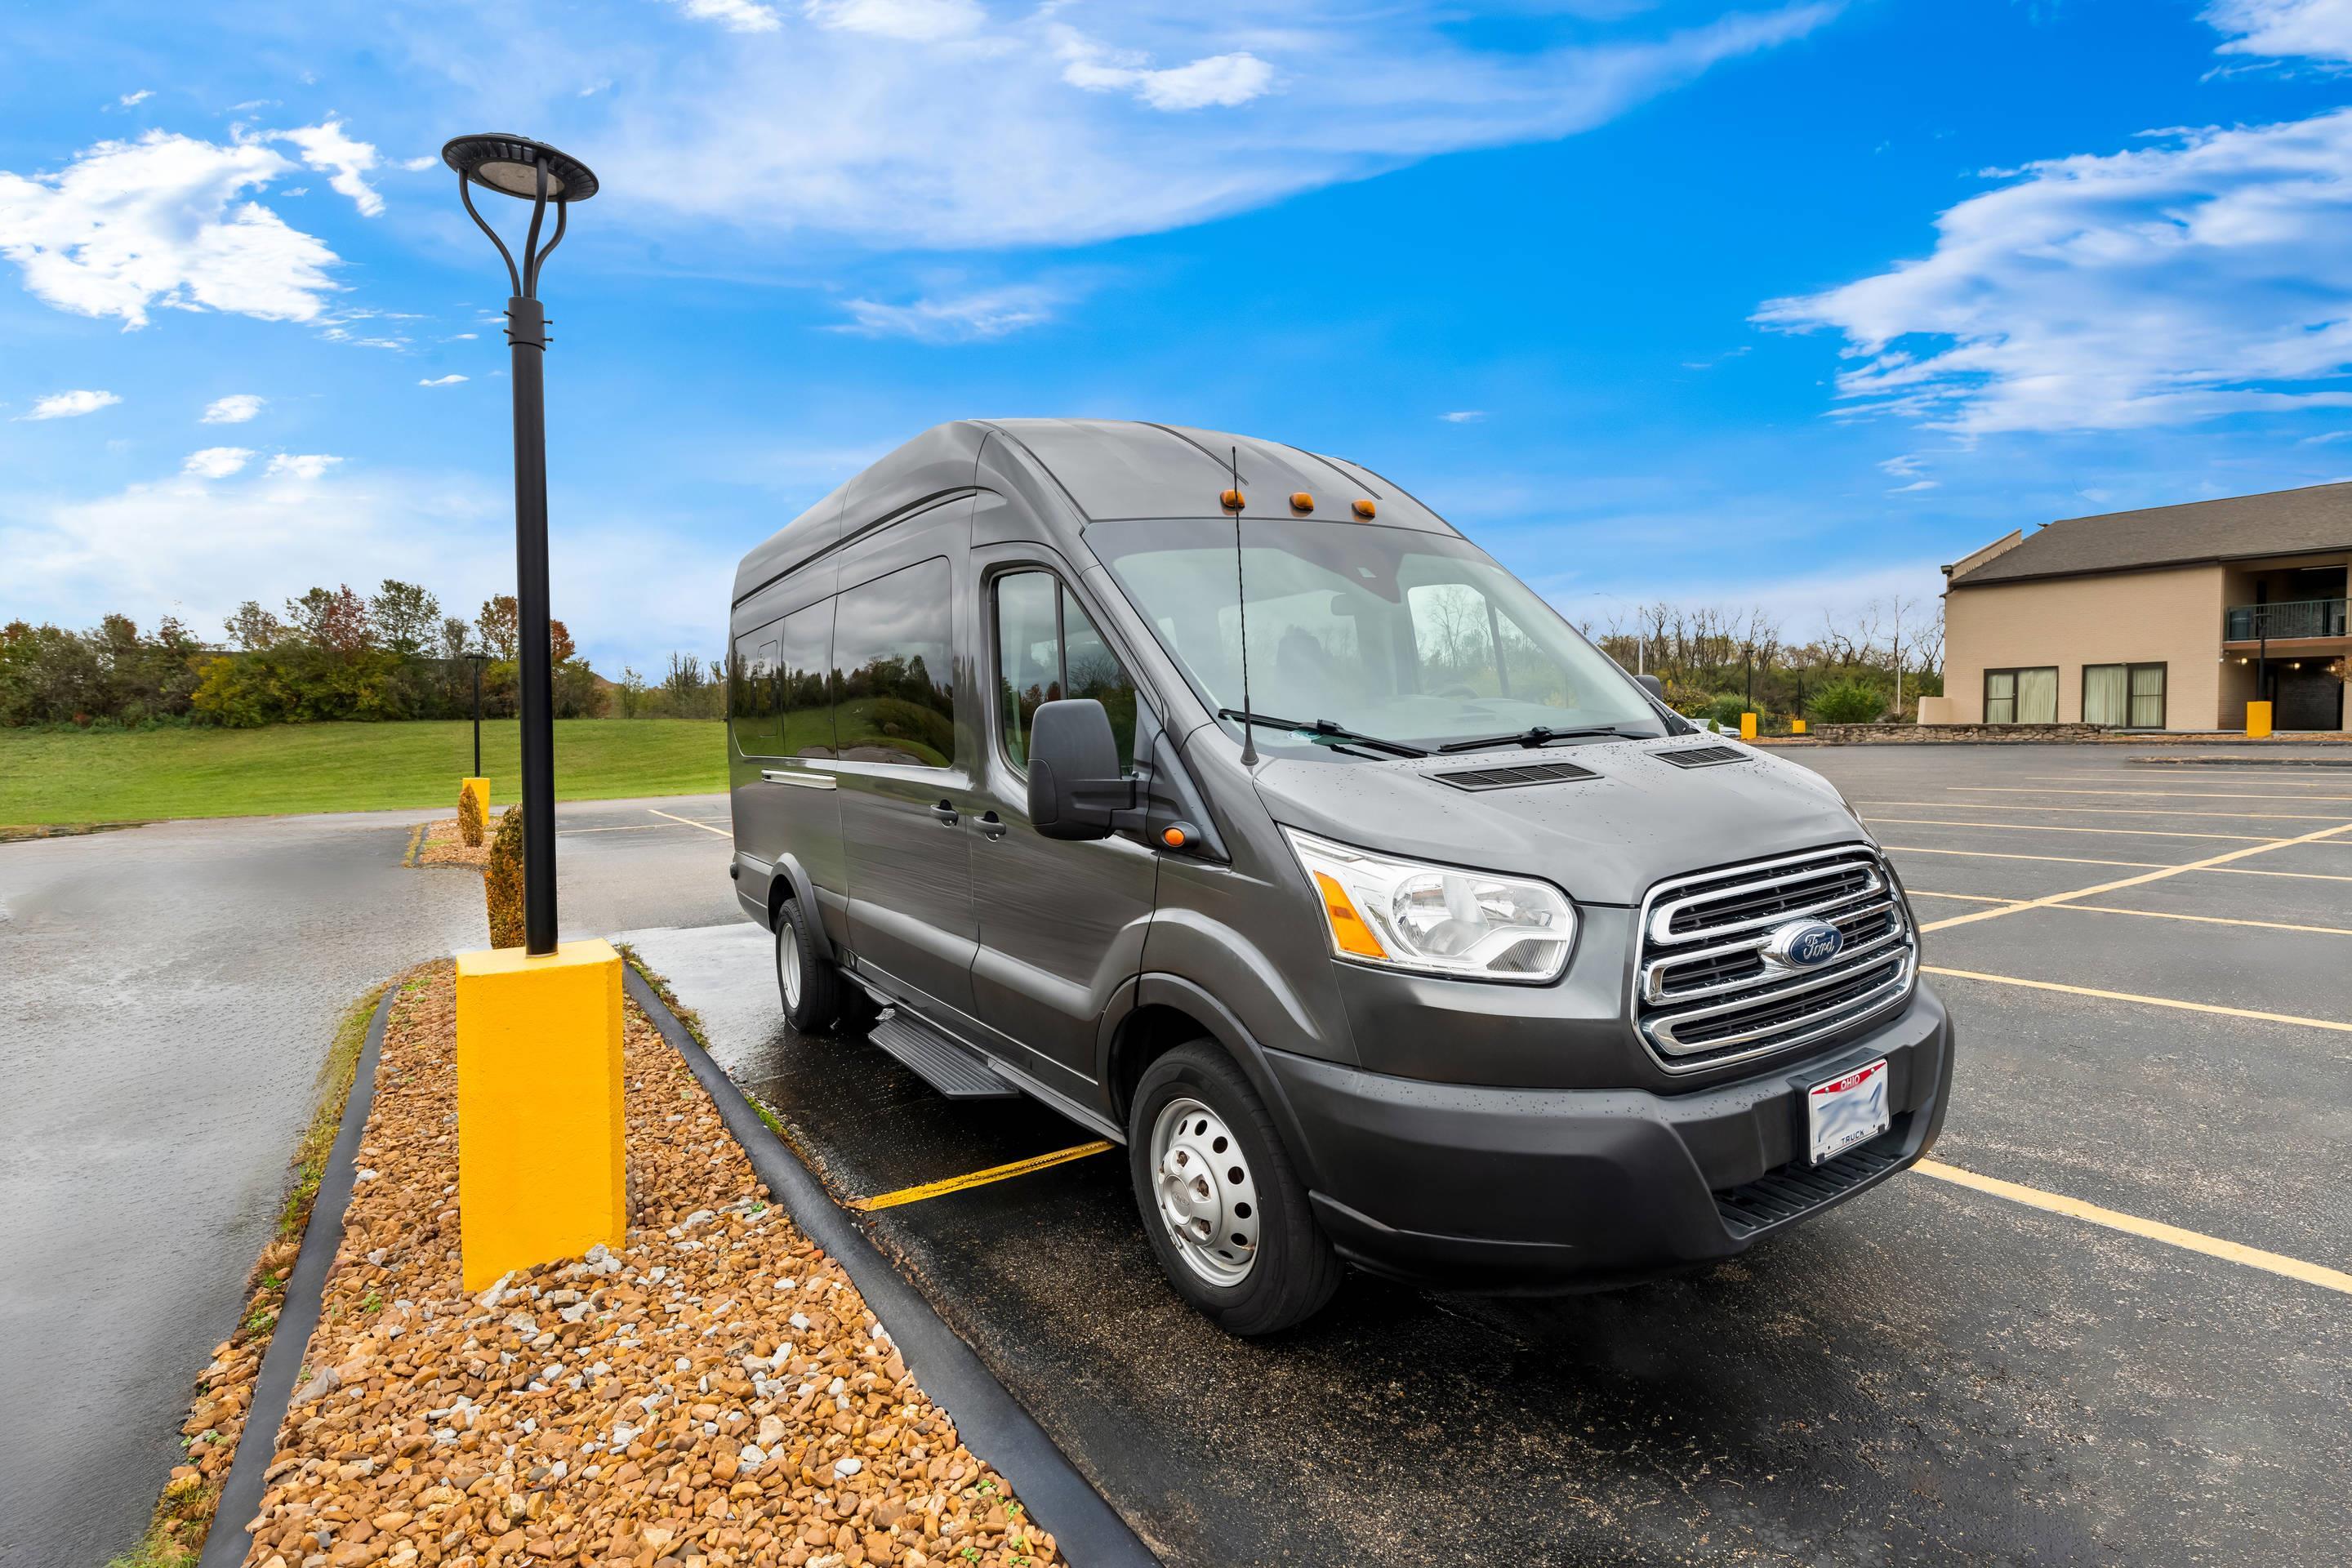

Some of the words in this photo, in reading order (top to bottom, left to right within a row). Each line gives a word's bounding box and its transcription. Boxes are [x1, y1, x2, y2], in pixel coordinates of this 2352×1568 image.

[1803, 932, 1835, 960] Ford
[1841, 1074, 1860, 1089] OHIO
[1842, 1129, 1864, 1144] TRUCK
